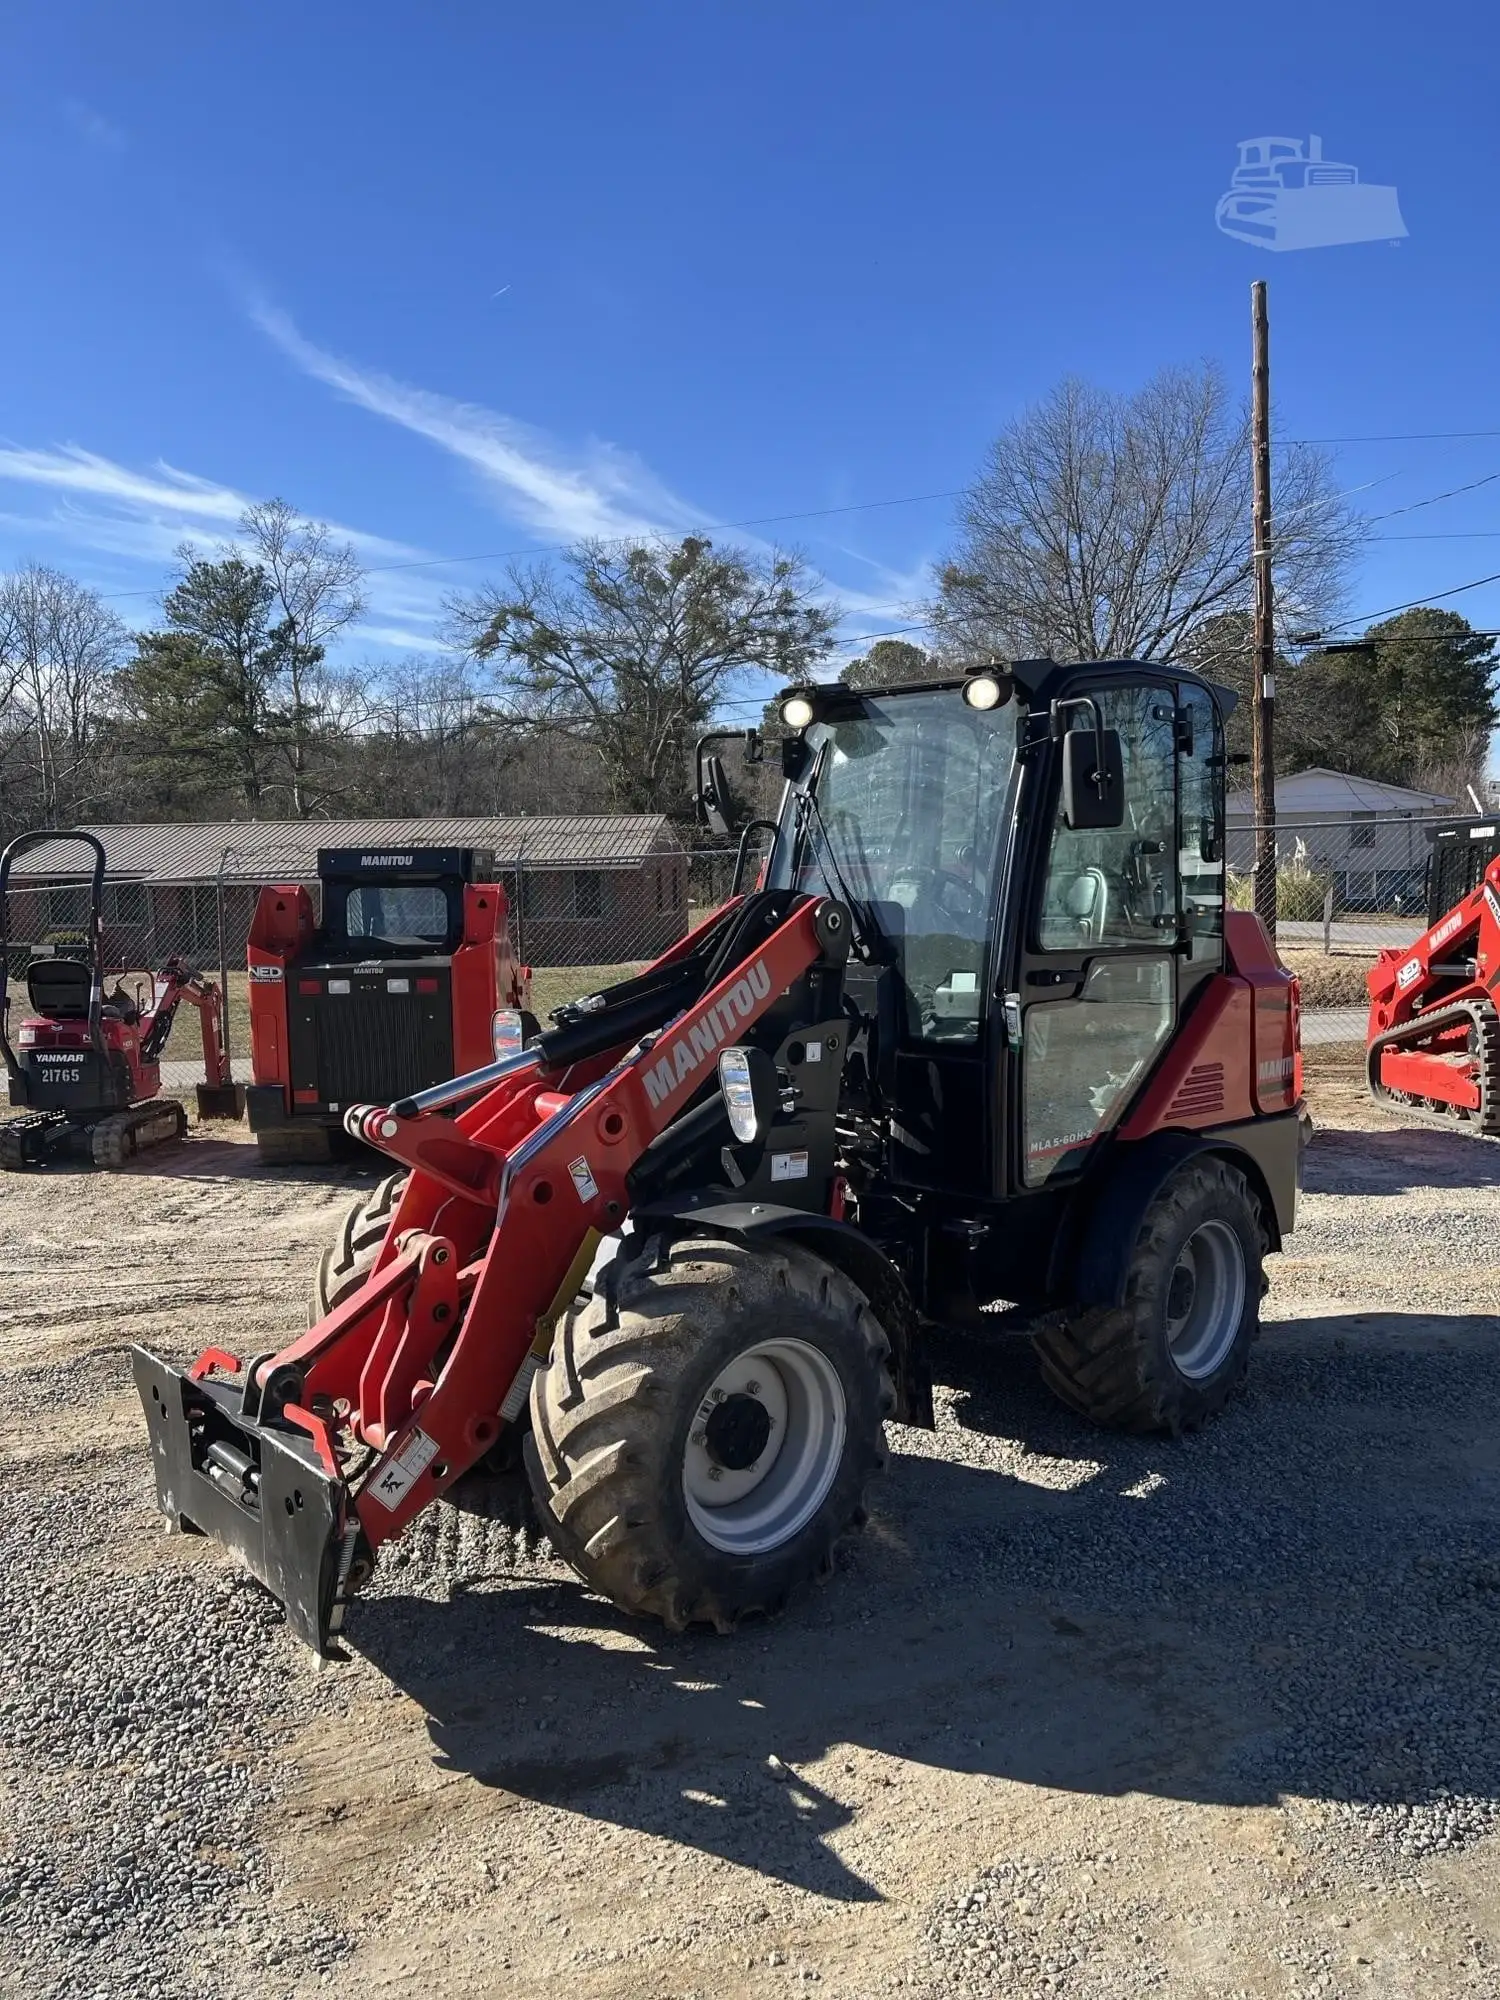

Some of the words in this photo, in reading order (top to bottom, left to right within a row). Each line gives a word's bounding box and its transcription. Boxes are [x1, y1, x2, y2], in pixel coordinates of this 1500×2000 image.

[361, 855, 413, 866] MANITOU
[1429, 911, 1462, 951] MANITOU
[249, 966, 283, 978] NED
[353, 967, 384, 975] MANITOU
[641, 959, 771, 1109] MANITOU
[35, 1054, 84, 1062] YANMAR
[42, 1069, 80, 1082] 21765
